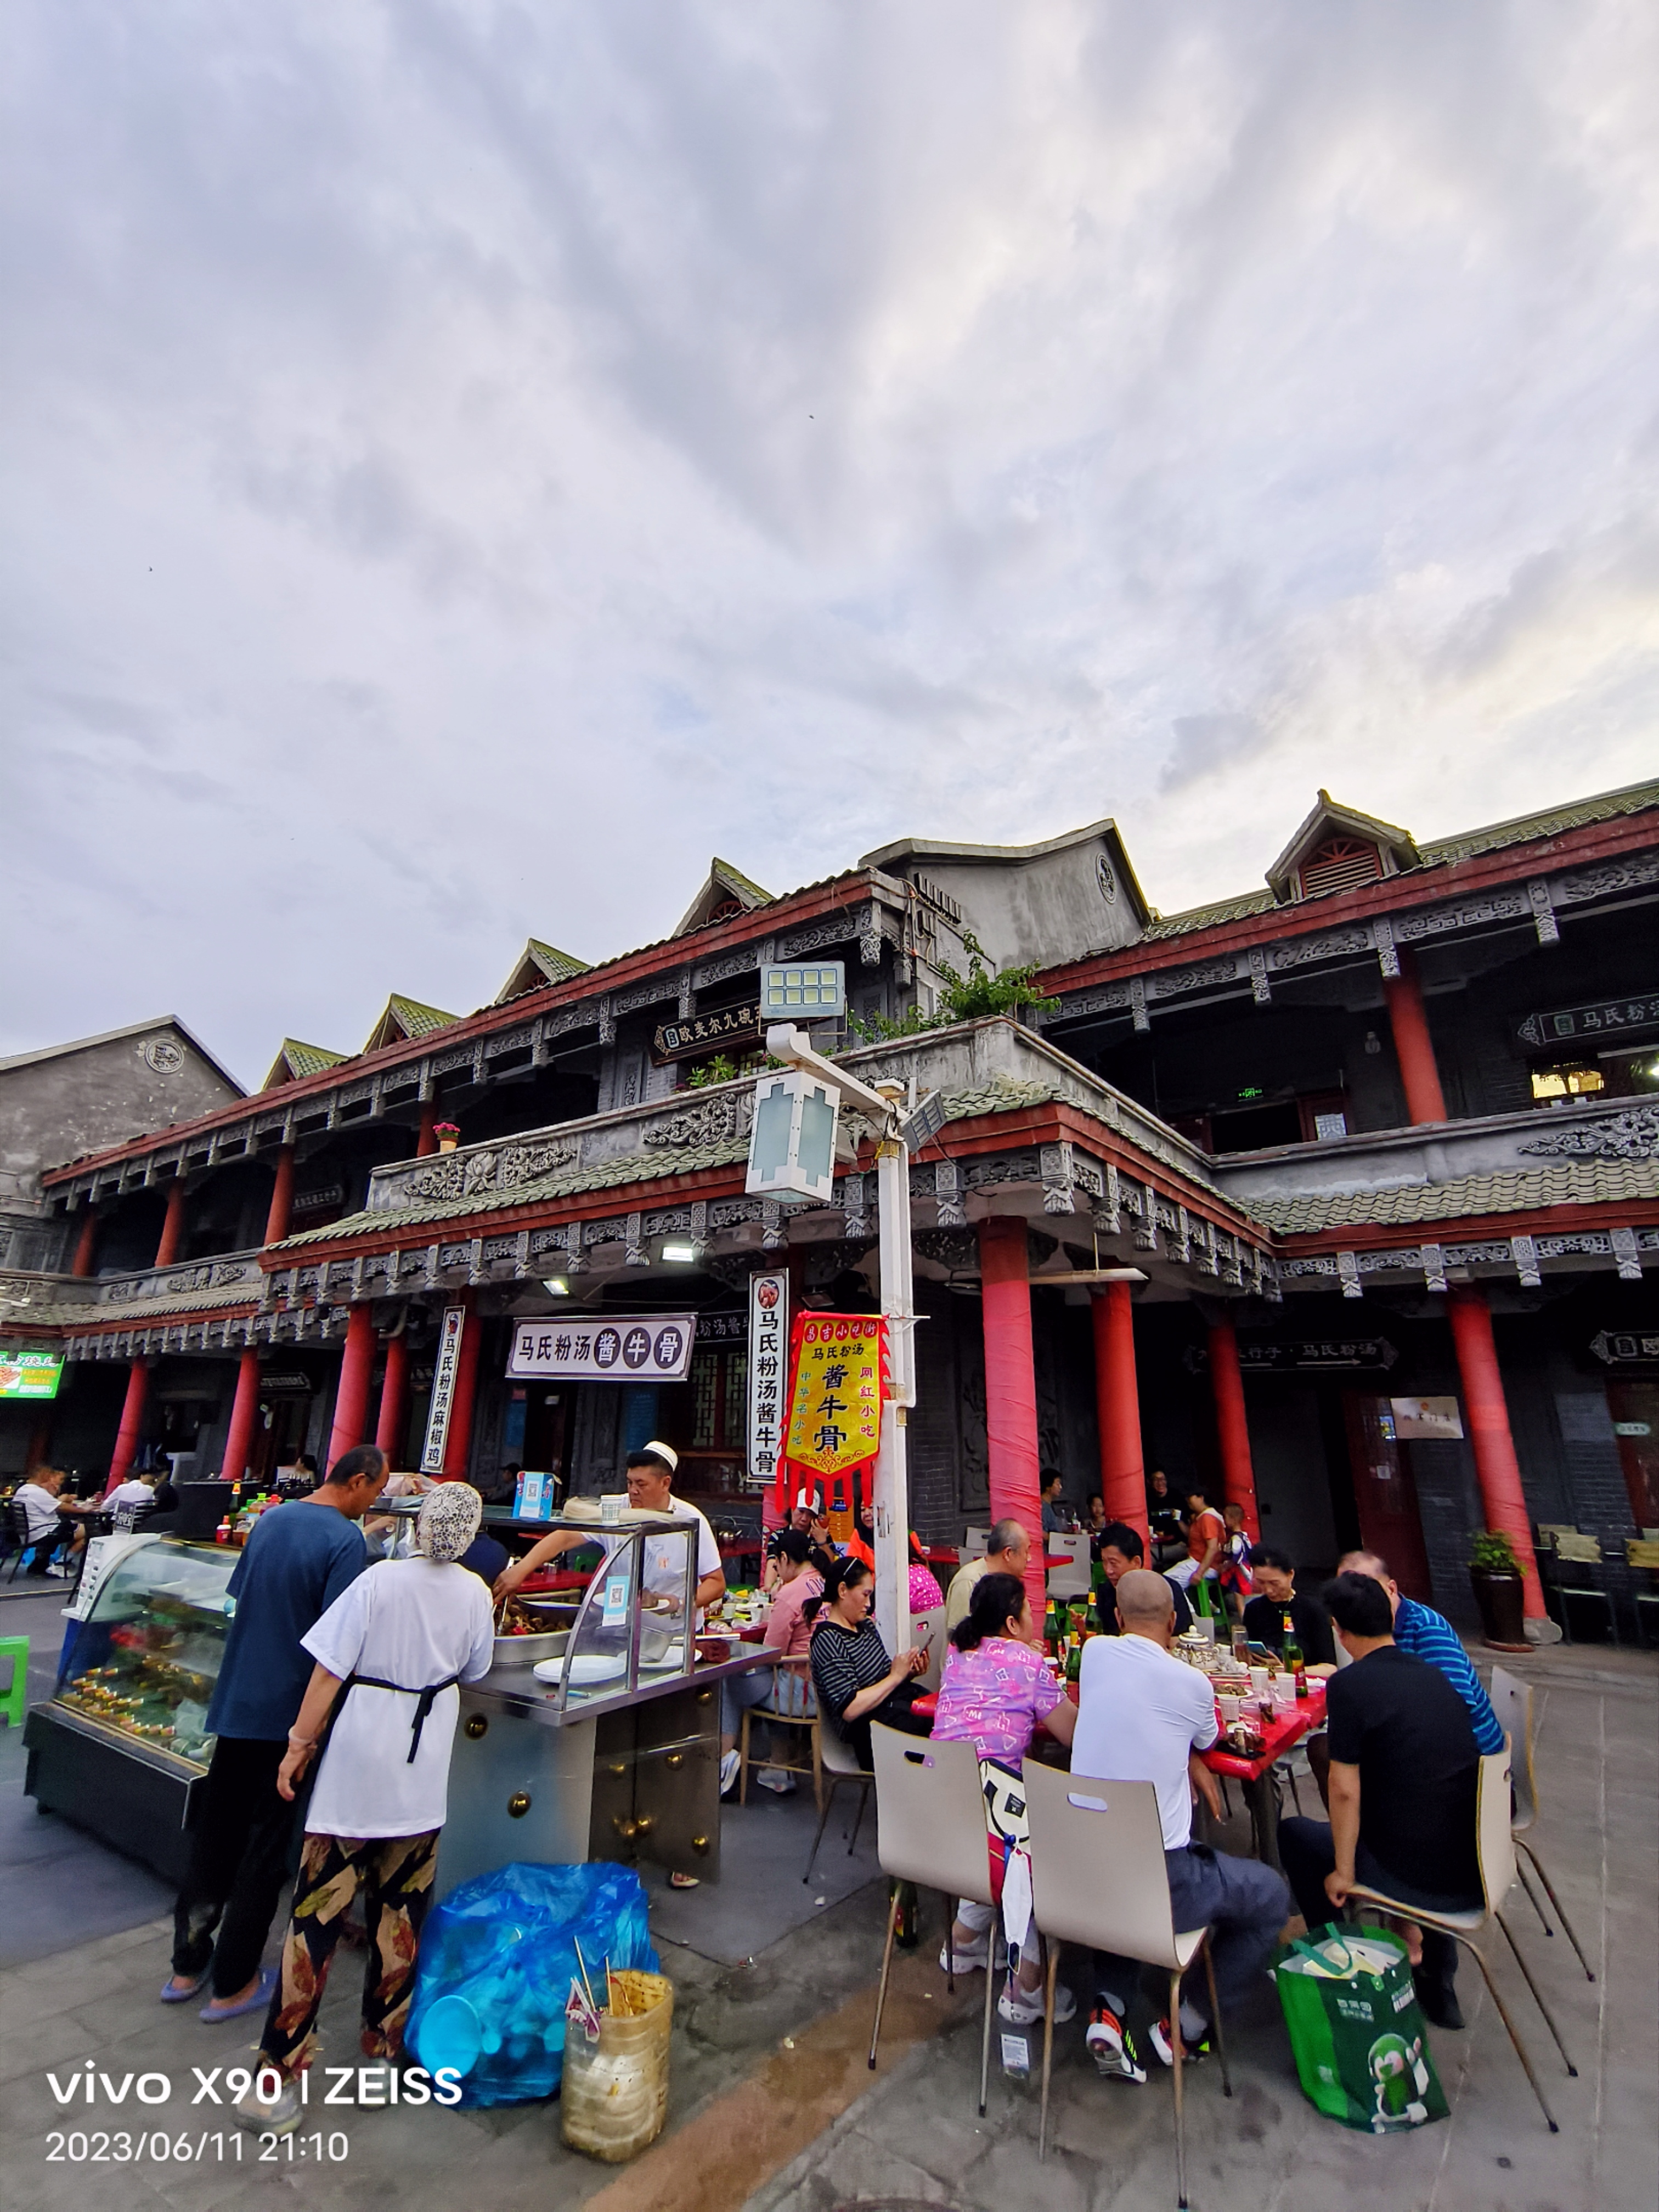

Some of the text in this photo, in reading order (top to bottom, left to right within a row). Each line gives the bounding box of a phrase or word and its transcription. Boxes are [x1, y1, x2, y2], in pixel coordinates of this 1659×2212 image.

[679, 1006, 759, 1042] 欧麦尔九碗
[518, 1332, 679, 1363] 马氏粉汤酱牛骨
[696, 1315, 748, 1337] 粉汤酱
[806, 1323, 877, 1341] 昌吉小吃街
[812, 1344, 865, 1361] 马氏粉汤
[426, 1338, 456, 1465] 马氏粉汤麻椒鸡
[755, 1310, 779, 1472] 马氏粉汤酱牛骨
[792, 1371, 811, 1446] 中华名小吃
[814, 1364, 849, 1452] 酱牛骨
[860, 1367, 876, 1437] 网红小吃
